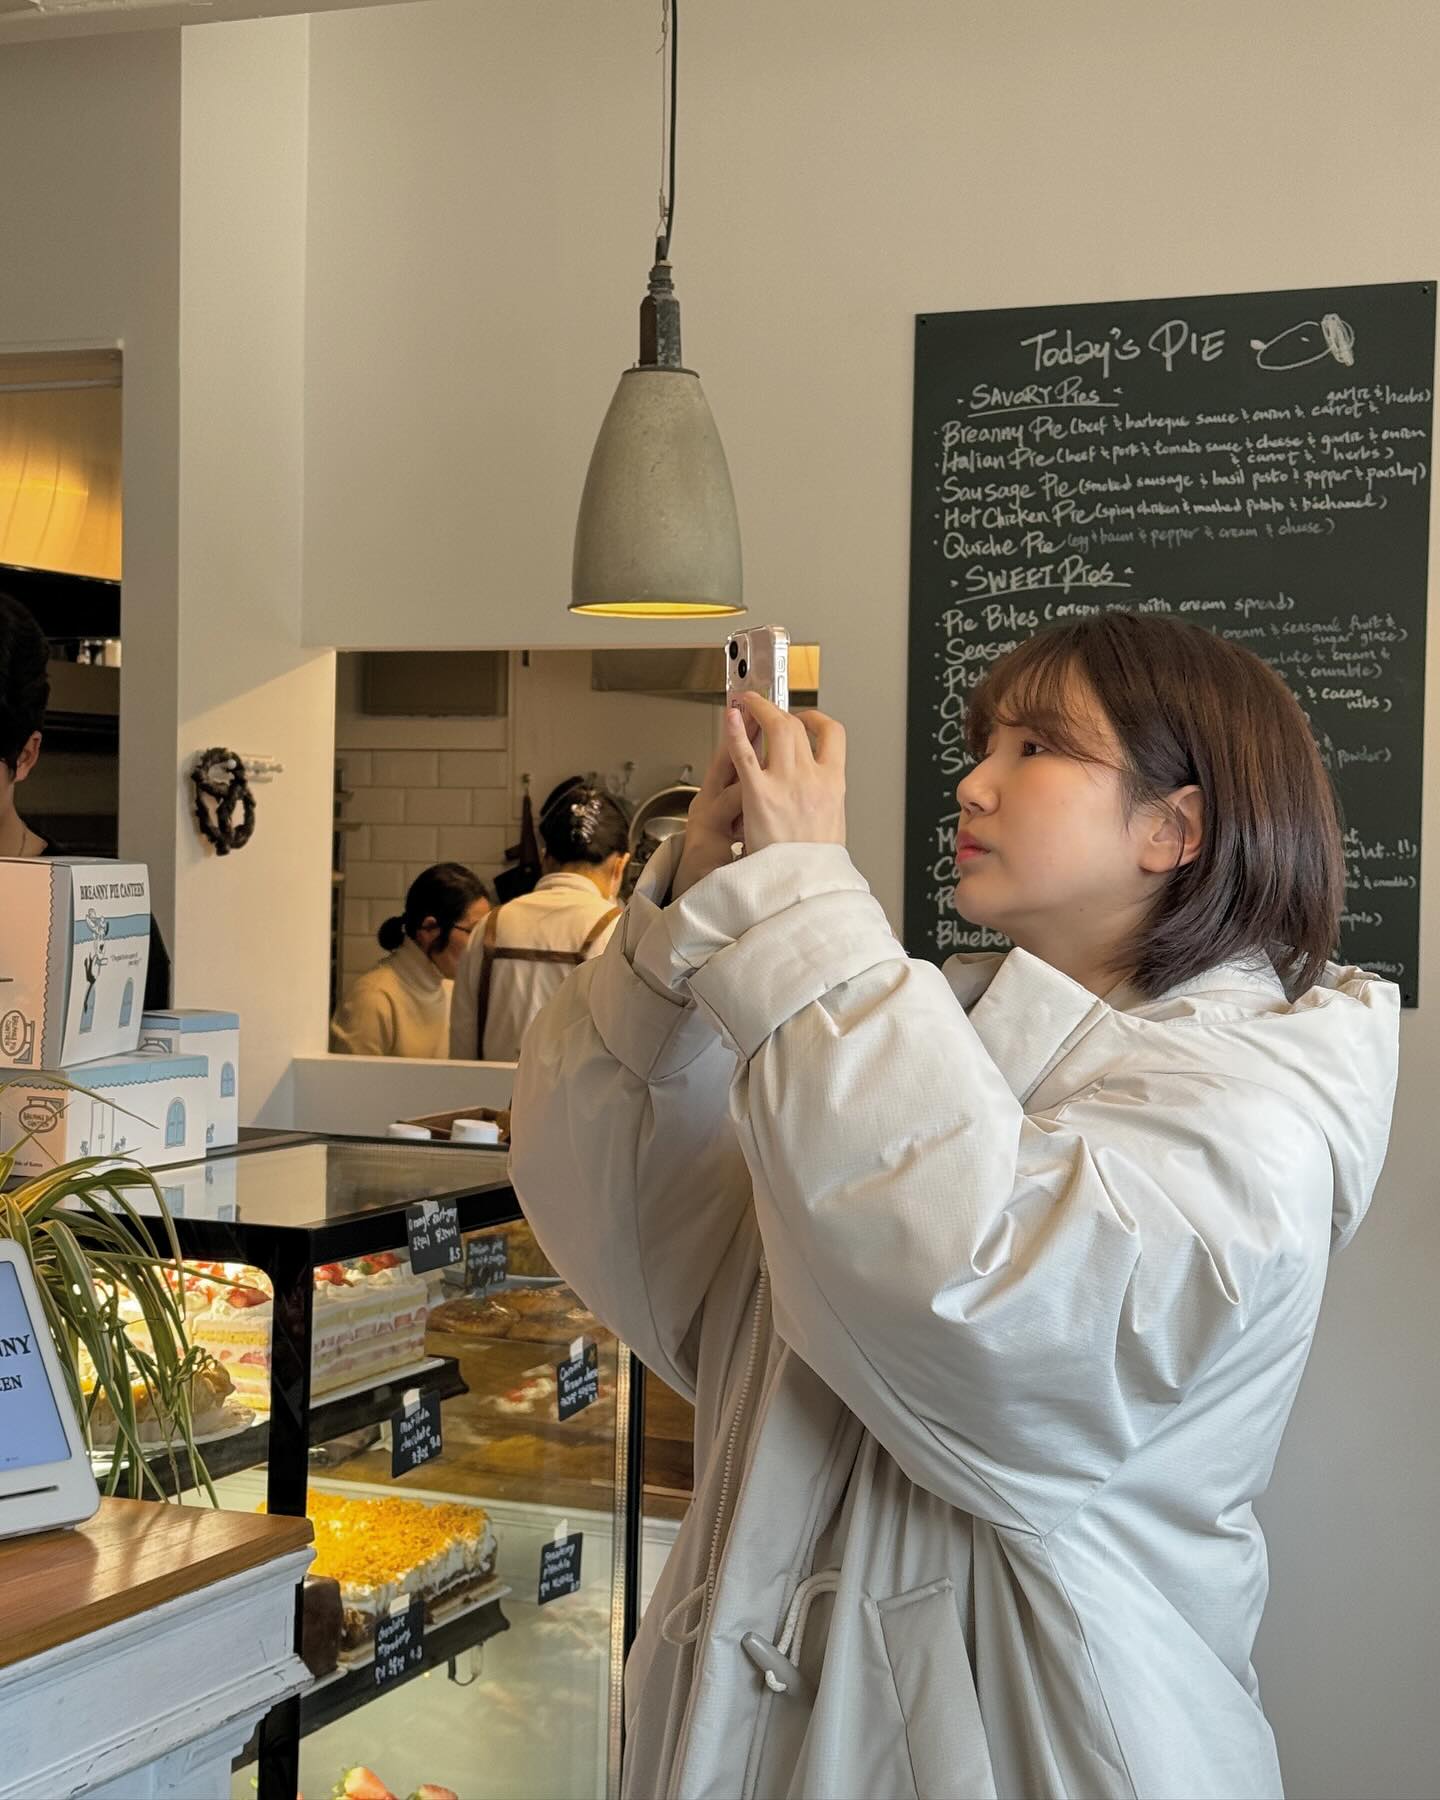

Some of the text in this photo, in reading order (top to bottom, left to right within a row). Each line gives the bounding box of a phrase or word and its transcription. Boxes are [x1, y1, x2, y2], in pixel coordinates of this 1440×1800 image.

[1020, 320, 1226, 378] Today's PIE
[942, 420, 1025, 449] Breanny
[1028, 416, 1068, 442] Pie
[1195, 412, 1239, 426] sauce
[1310, 401, 1367, 418] carrot
[942, 449, 1006, 476] Italian
[1007, 447, 1056, 470] Pie
[942, 476, 1037, 509] Sausage
[1038, 471, 1077, 501] Pie
[1136, 474, 1194, 494] sausage
[1212, 468, 1245, 486] basil
[944, 505, 982, 530] Hot
[982, 505, 1052, 529] Chicken
[1052, 499, 1097, 527] Pie
[943, 531, 1019, 559] Quiche
[1020, 530, 1067, 559] Pie
[965, 564, 1055, 593] SWEET
[941, 609, 979, 638] Pie
[981, 604, 1040, 632] Bites
